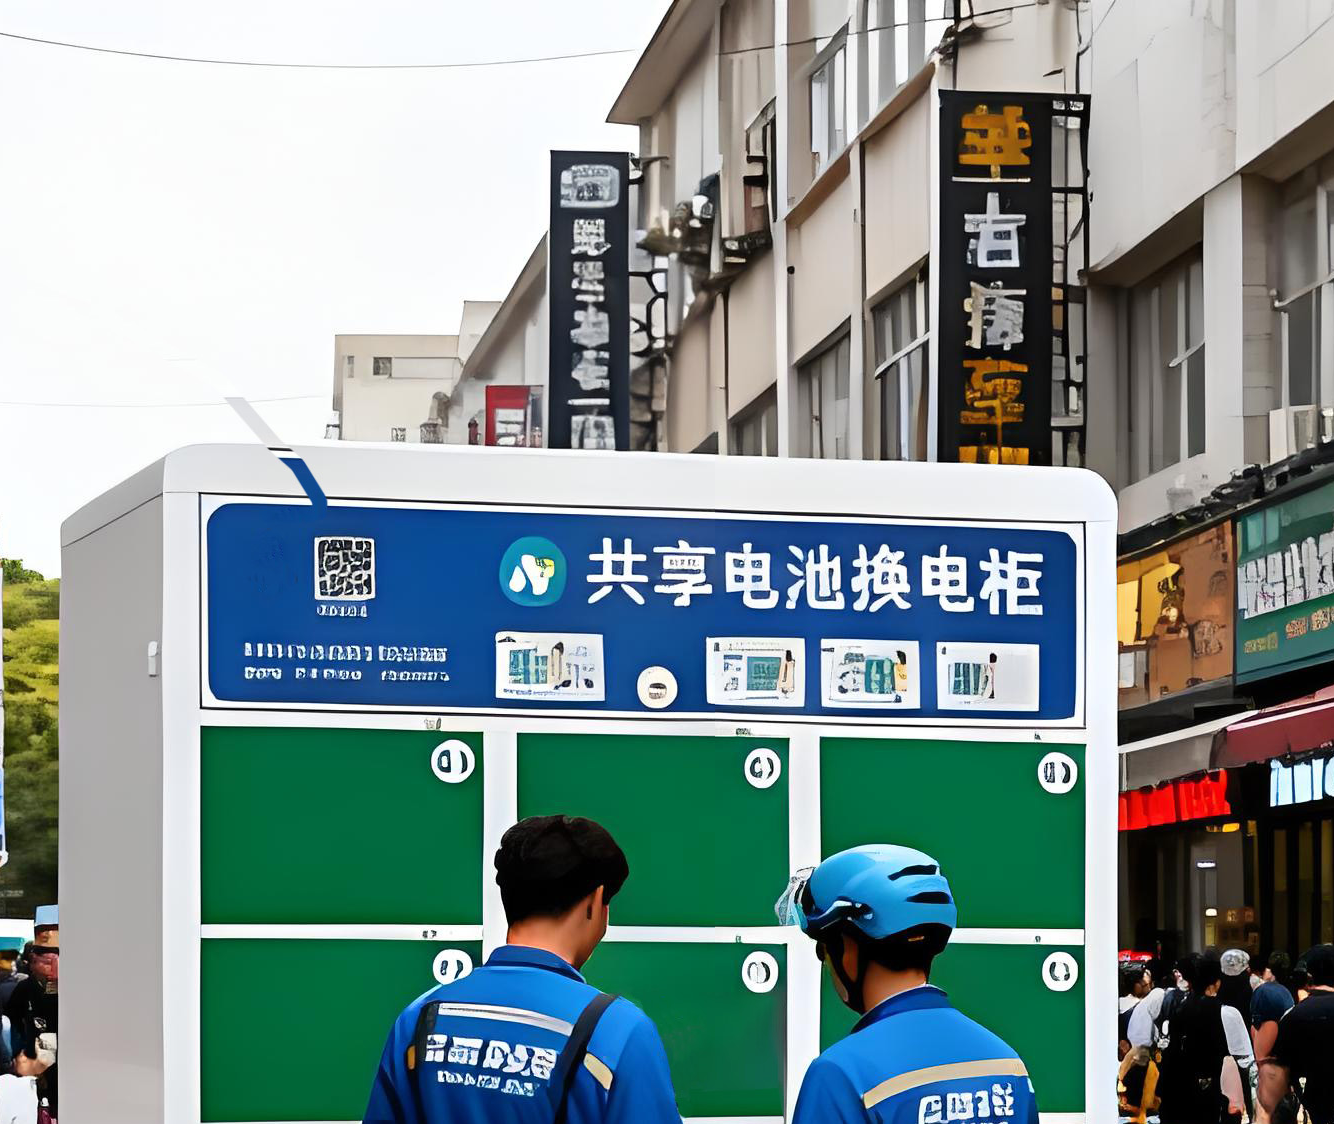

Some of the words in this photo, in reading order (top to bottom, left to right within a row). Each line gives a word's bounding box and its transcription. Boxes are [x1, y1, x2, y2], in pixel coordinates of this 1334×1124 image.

[586, 536, 1044, 616] 共享电池换电柜
